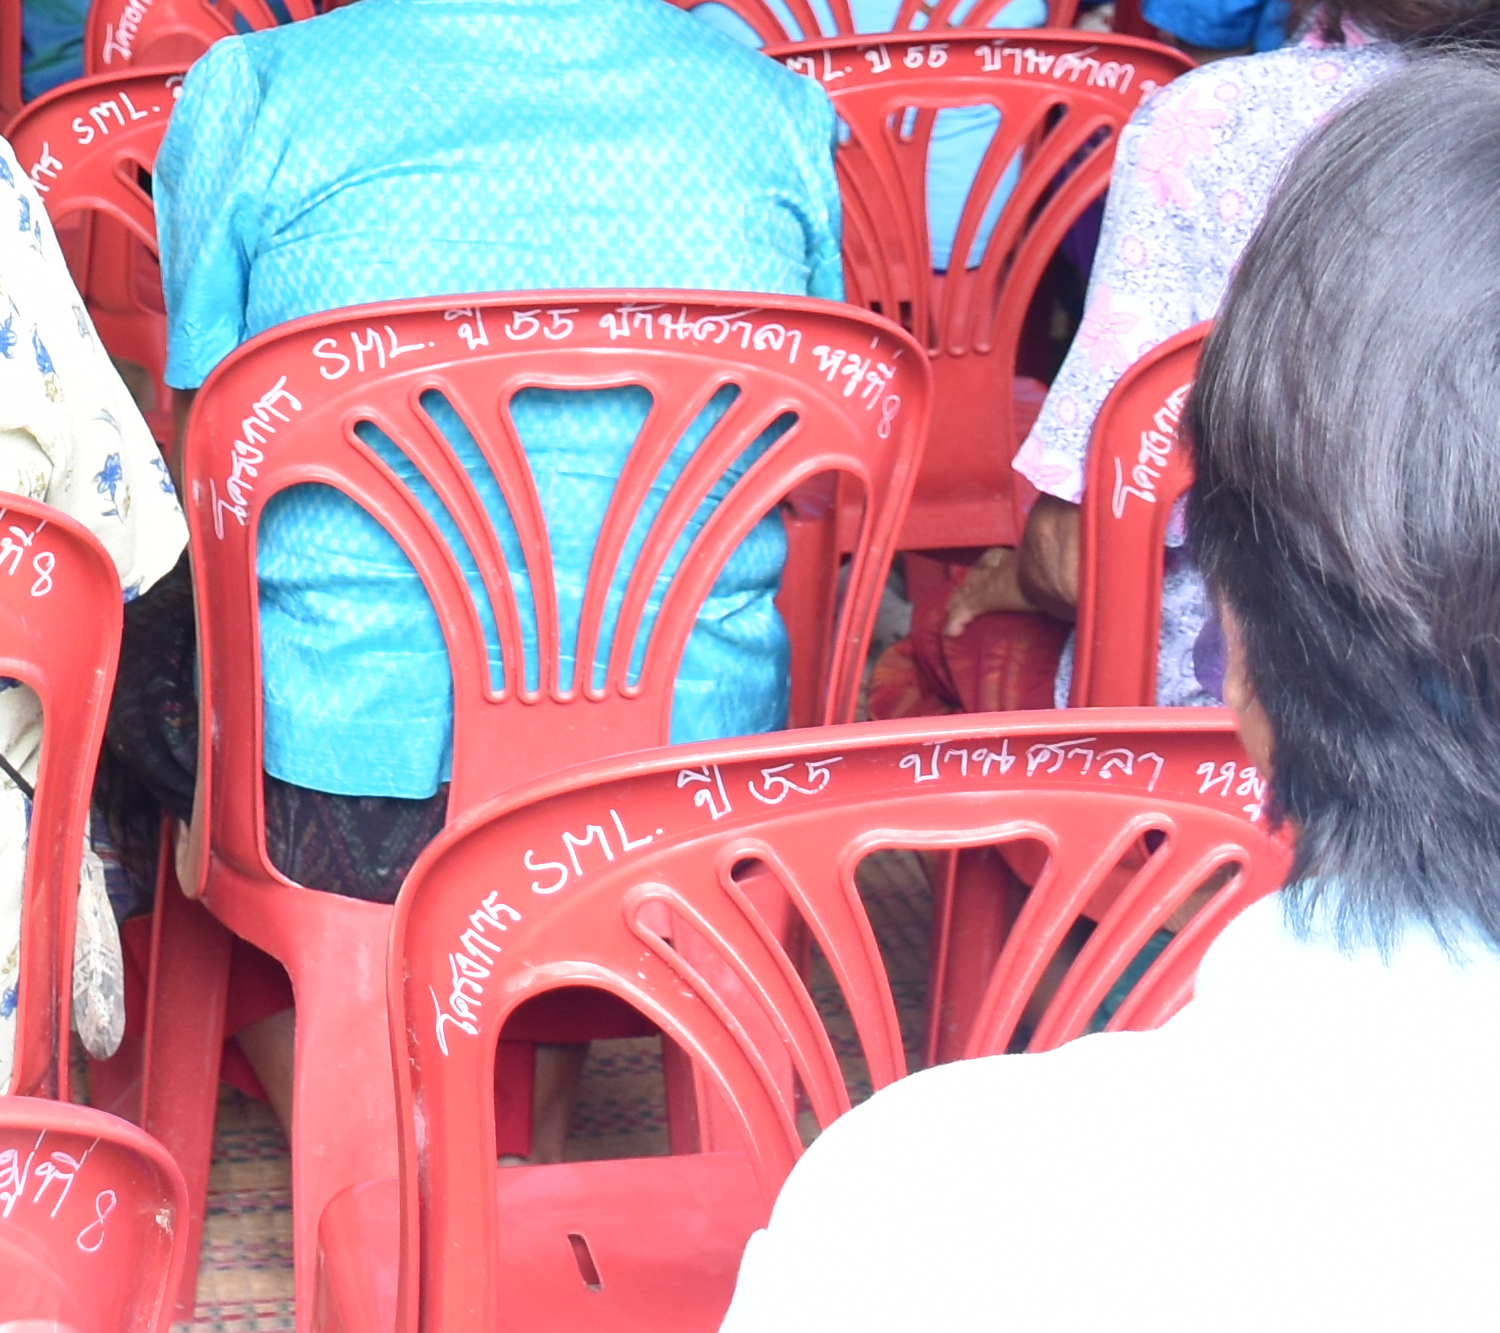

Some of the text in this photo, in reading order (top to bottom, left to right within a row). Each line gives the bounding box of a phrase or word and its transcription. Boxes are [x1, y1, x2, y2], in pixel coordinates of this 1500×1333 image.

[71, 91, 161, 146] SML.
[311, 317, 435, 383] SML.
[503, 305, 582, 341] 55
[436, 890, 522, 1057] โครงการ
[522, 808, 665, 898] SML.
[747, 754, 845, 808] 55
